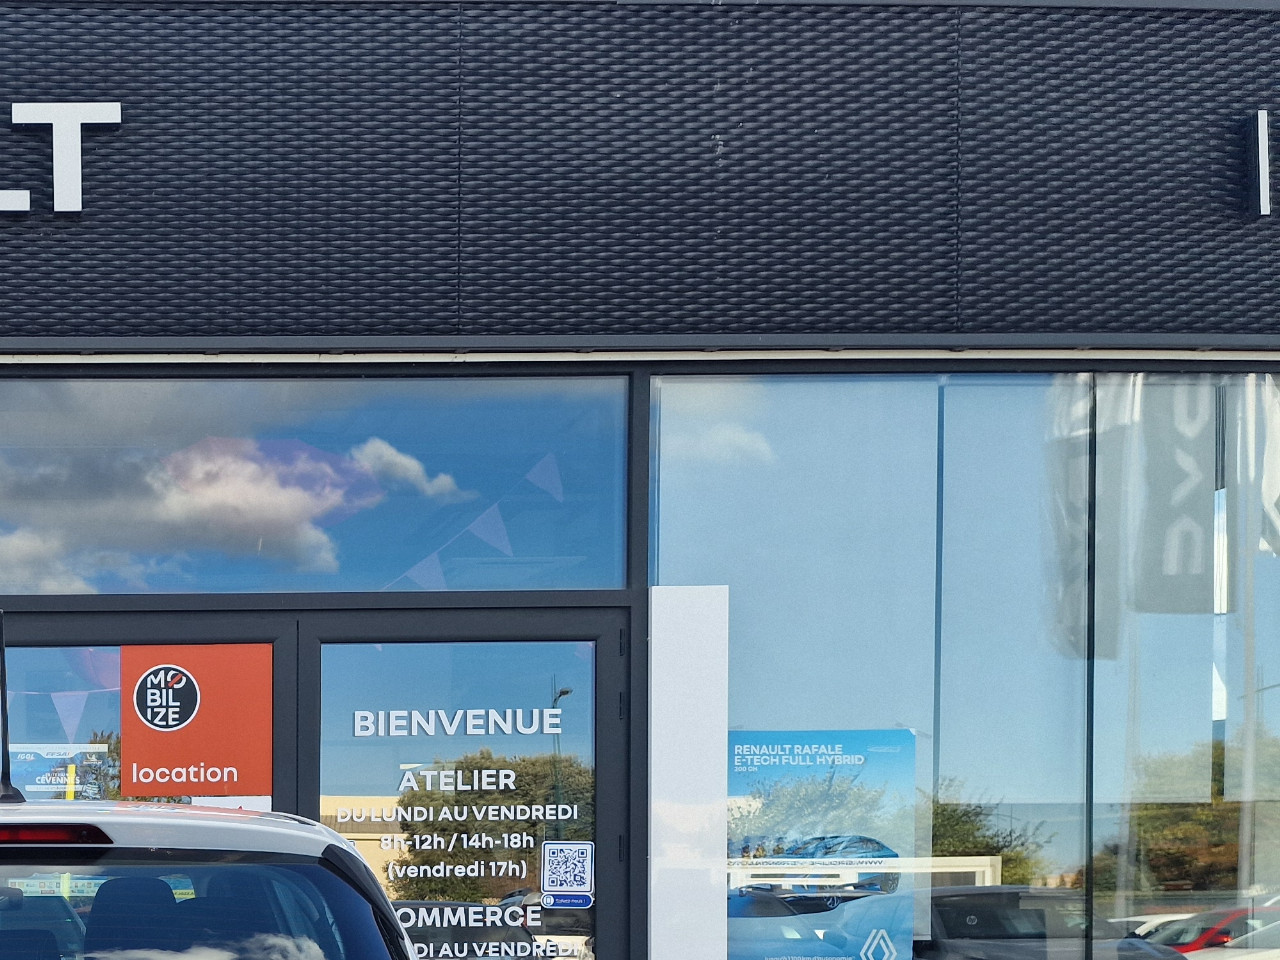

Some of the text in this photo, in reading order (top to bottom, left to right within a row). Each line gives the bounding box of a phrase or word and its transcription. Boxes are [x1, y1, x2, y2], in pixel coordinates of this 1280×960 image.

[353, 707, 562, 737] BIENVENUE
[734, 744, 842, 754] RENAULT RAFALE
[734, 754, 865, 765] E-TECH FULL HYBRID
[132, 762, 238, 783] location
[398, 769, 517, 791] ATELIER
[336, 804, 578, 823] DU LUNDI AU VENDREDI
[380, 834, 446, 851] 8h-12h
[460, 832, 535, 849] 14h-18h
[387, 861, 528, 880] (vendredi 17h)
[438, 942, 468, 958] AU
[473, 941, 580, 958] VENDREDI
